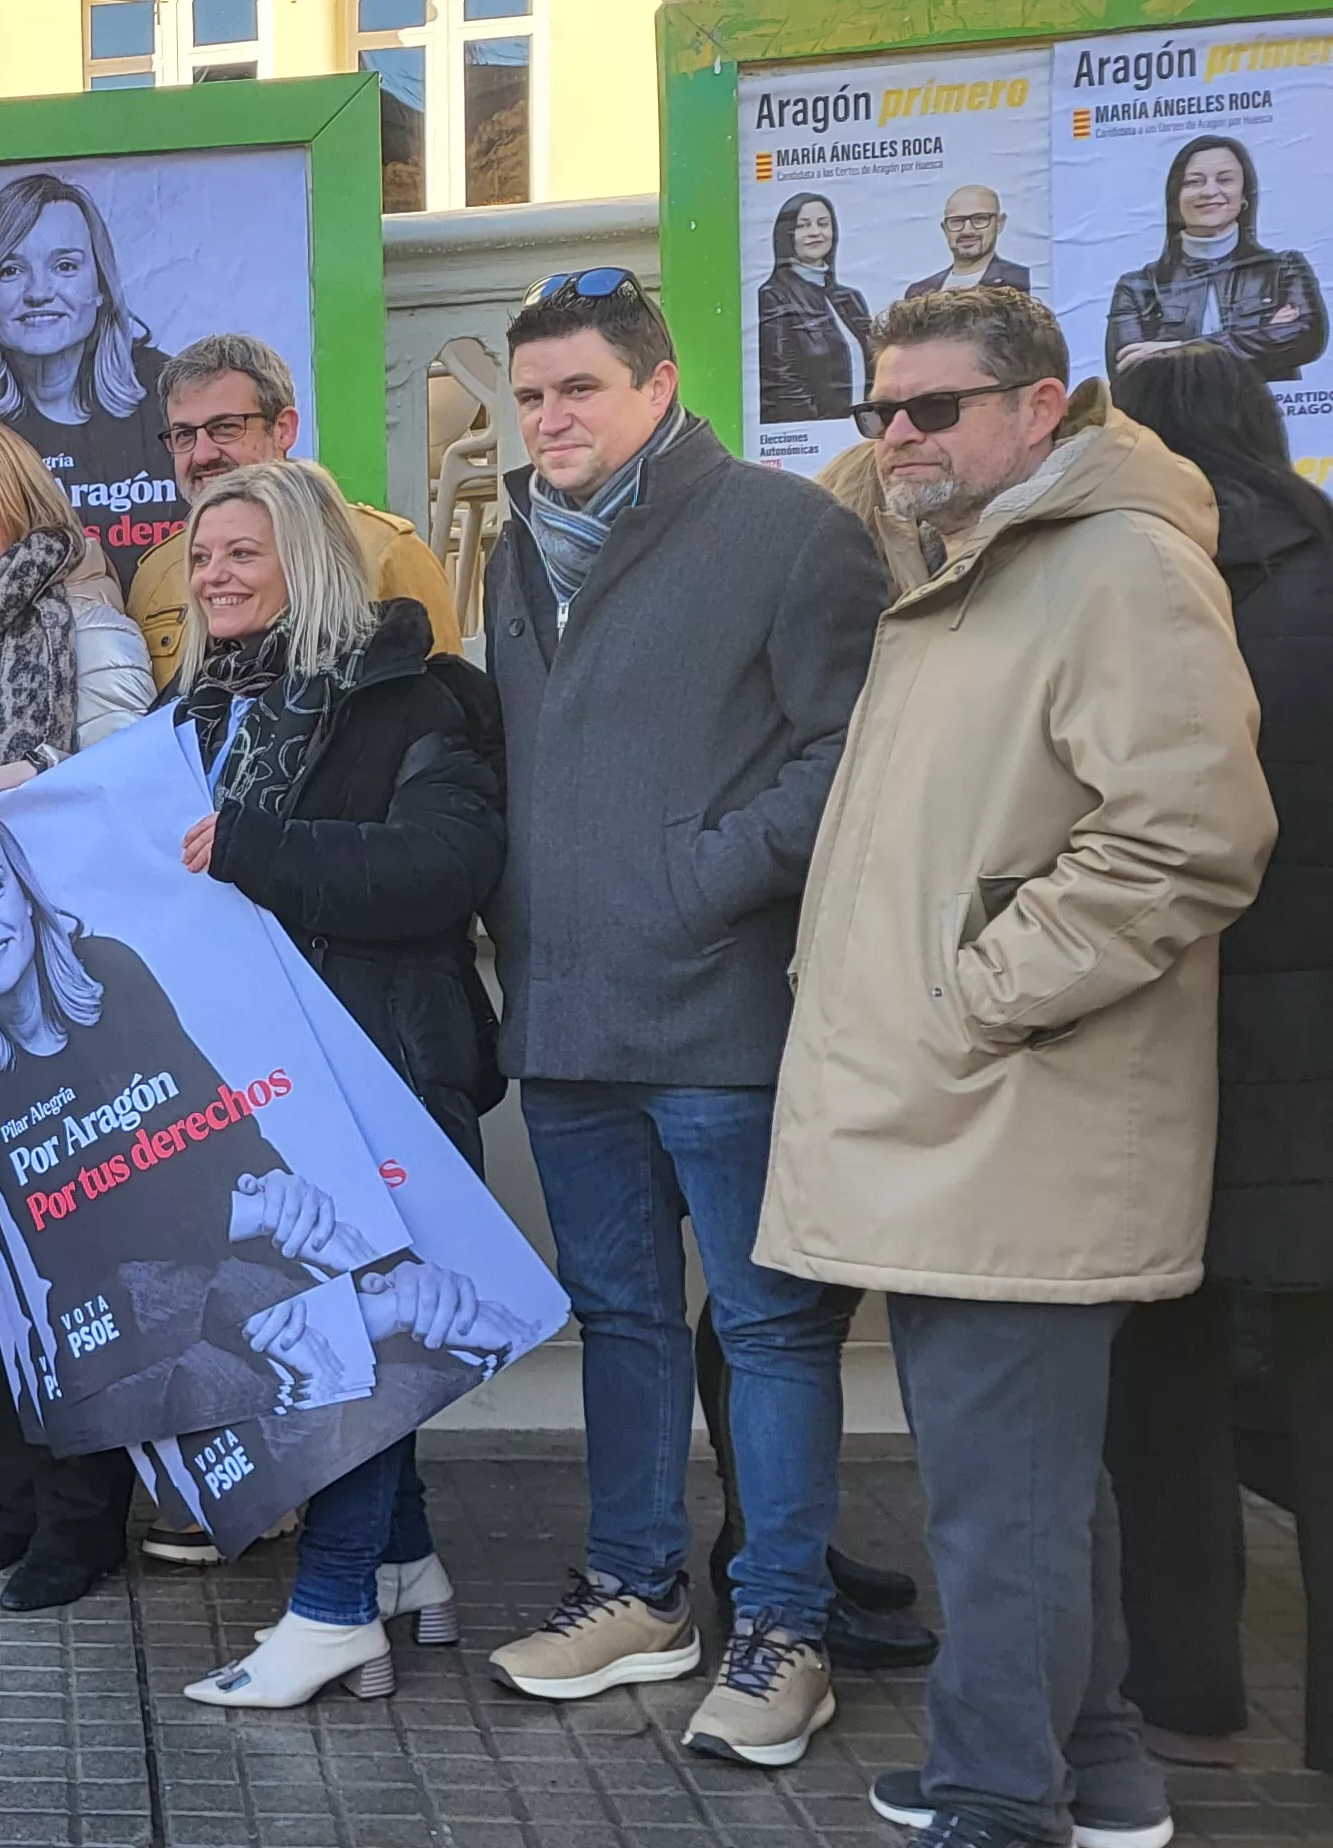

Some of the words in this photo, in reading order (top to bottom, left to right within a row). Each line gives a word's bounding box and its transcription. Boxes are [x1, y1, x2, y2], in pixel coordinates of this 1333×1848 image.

[1073, 40, 1196, 91] Aragón
[756, 84, 871, 133] Aragón
[878, 77, 1030, 127] primero
[1095, 98, 1149, 123] MARÍA
[1153, 96, 1225, 118] ÁNGELES
[1229, 90, 1272, 111] ROCA
[777, 143, 826, 167] MARÍA
[830, 141, 898, 162] ÁNGELES
[902, 136, 943, 156] ROCA
[760, 433, 808, 445] Elecciones
[760, 444, 819, 457] Autonómicas
[0, 1115, 29, 1143] Pilar
[29, 1086, 76, 1126] Alegría
[9, 1132, 59, 1187] Por
[60, 1071, 179, 1157] Aragón
[26, 1179, 77, 1232] Por
[77, 1153, 131, 1200] tus
[130, 1068, 293, 1171] derechos
[60, 1295, 109, 1330] VOTA
[67, 1312, 120, 1359] PSOE
[194, 1428, 239, 1472] VOTA
[204, 1445, 255, 1500] PSOE
